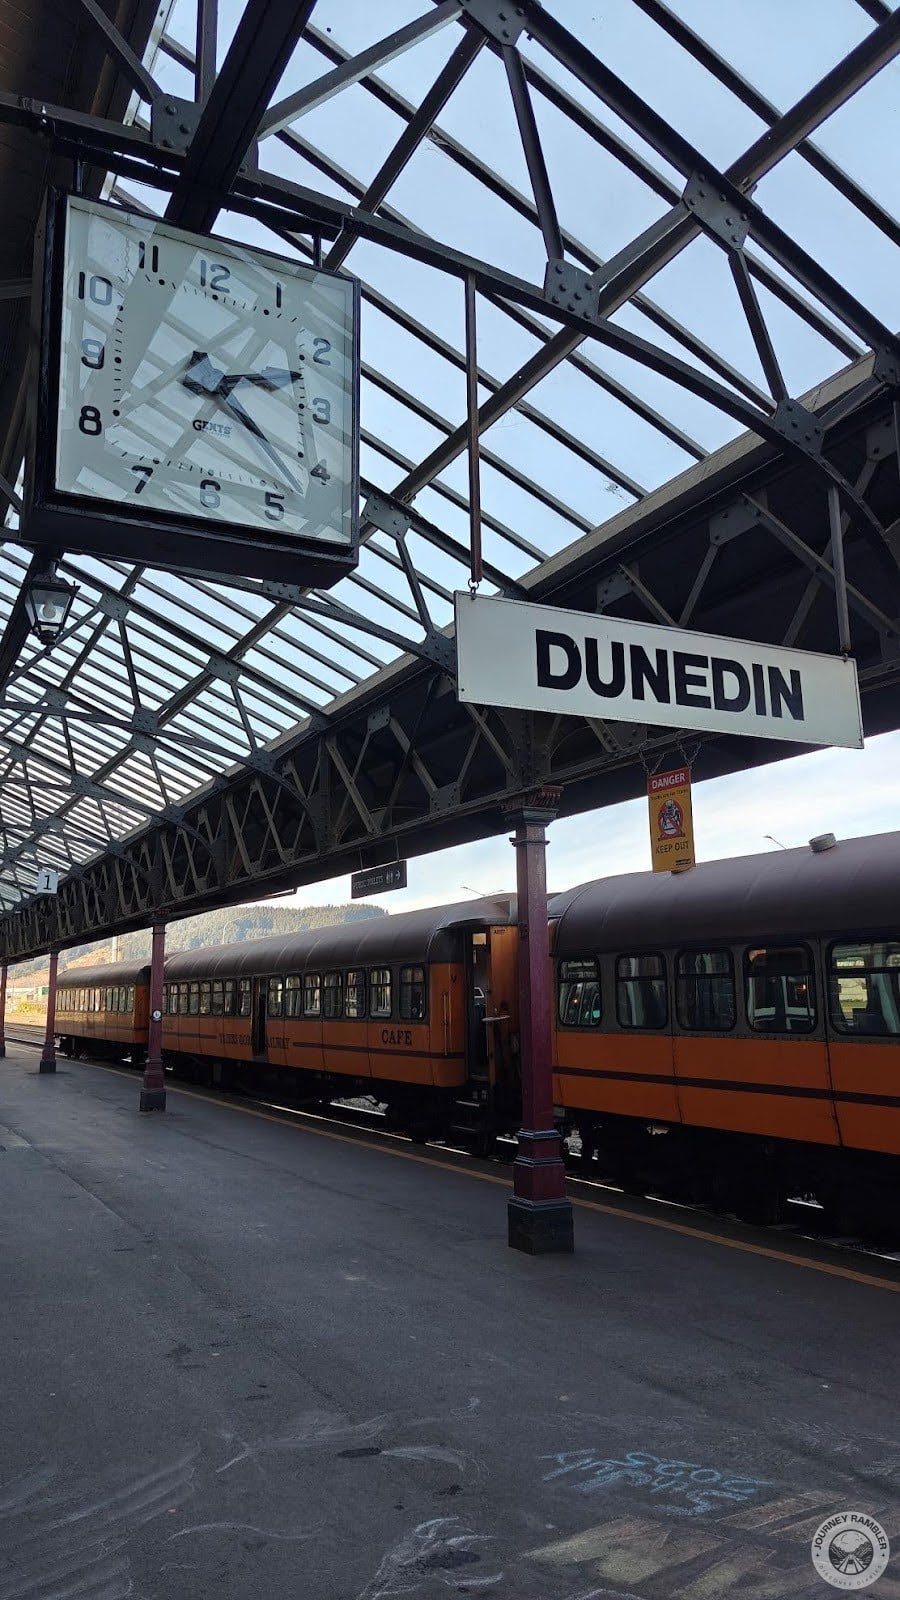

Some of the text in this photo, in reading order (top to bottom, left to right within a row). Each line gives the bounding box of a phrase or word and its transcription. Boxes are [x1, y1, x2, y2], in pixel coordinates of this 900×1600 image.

[138, 241, 159, 273] 11
[78, 271, 113, 306] 10
[200, 259, 231, 293] 12
[275, 282, 282, 308] 1
[81, 338, 105, 369] 9
[312, 337, 332, 367] 2
[79, 405, 103, 436] 8
[312, 397, 331, 425] 3
[131, 464, 154, 494] 7
[310, 459, 331, 486] 4
[199, 479, 221, 508] 6
[264, 492, 285, 521] 5
[535, 629, 804, 721] DUNEDIN
[652, 773, 685, 789] DANGER
[656, 841, 688, 854] KEEP OUT
[43, 874, 52, 890] 1
[382, 1030, 412, 1045] CAFE
